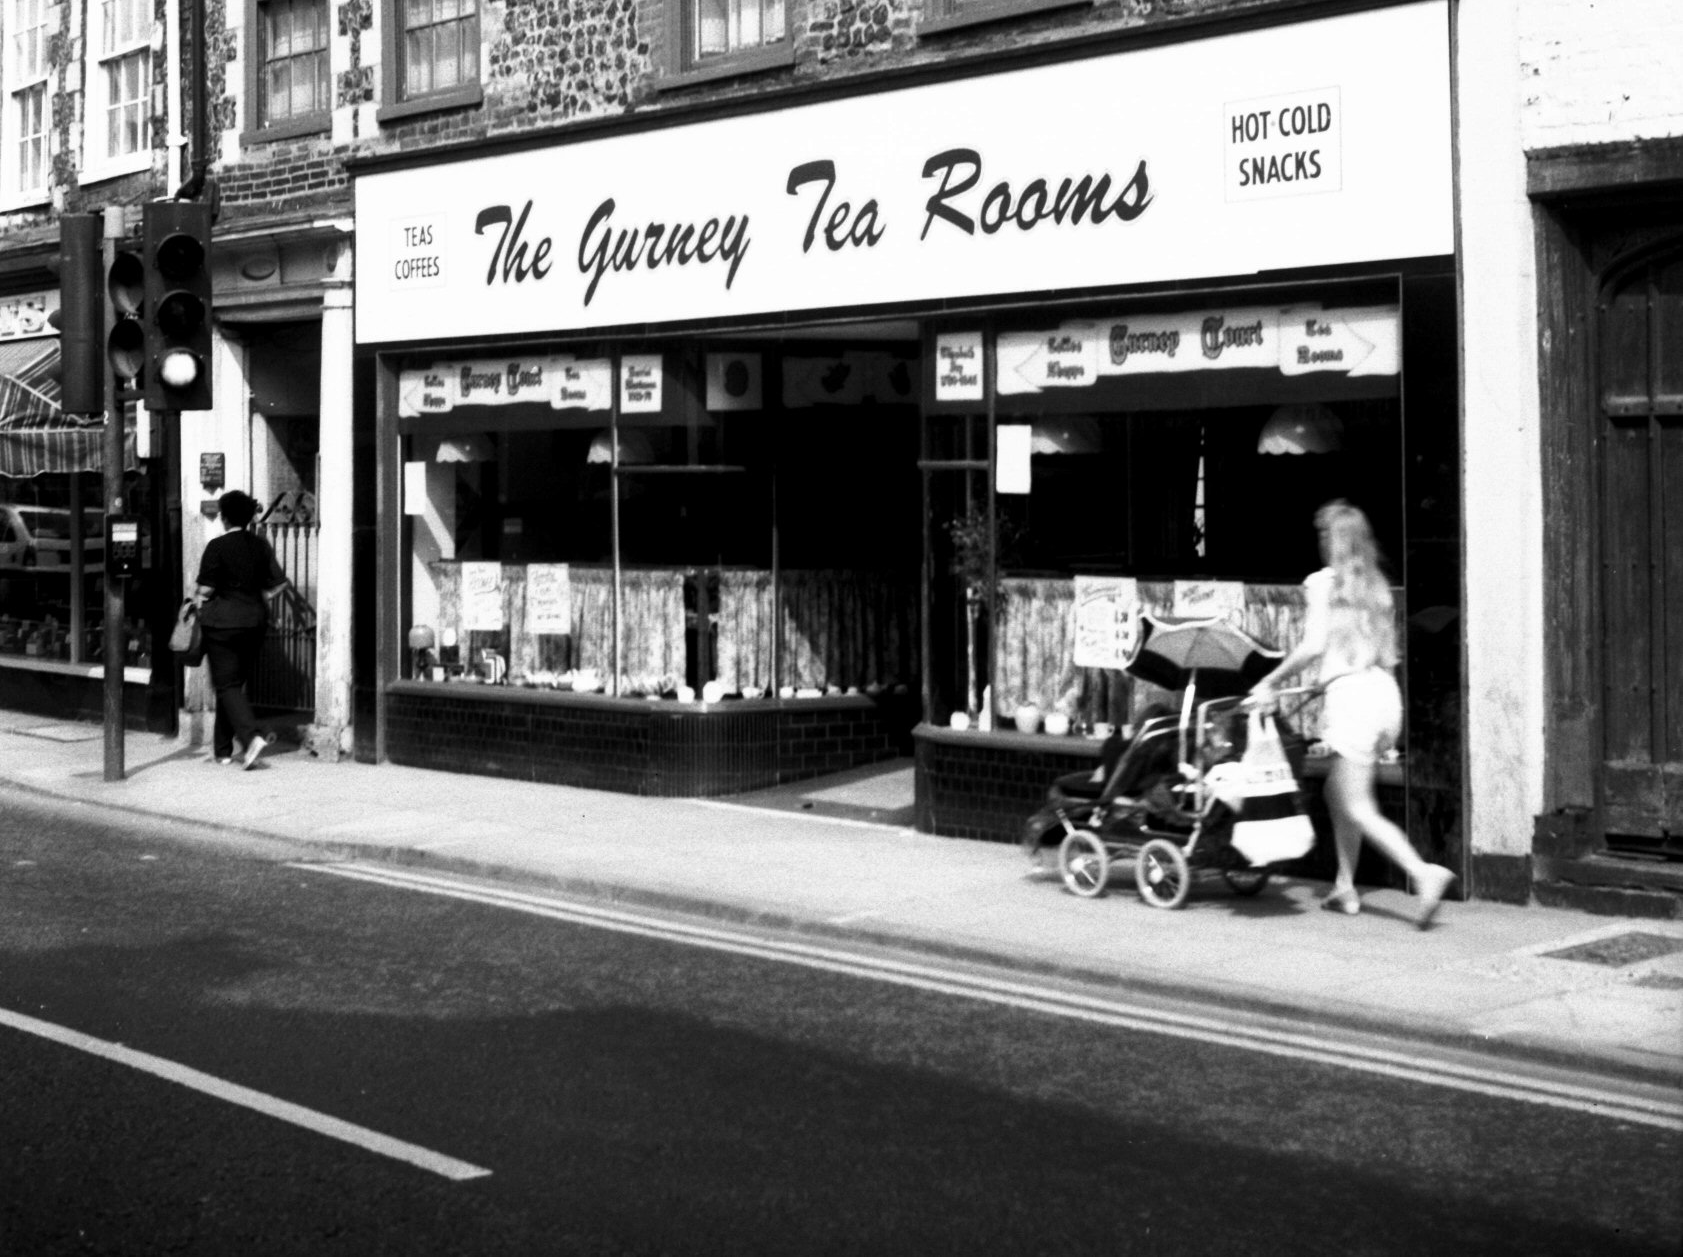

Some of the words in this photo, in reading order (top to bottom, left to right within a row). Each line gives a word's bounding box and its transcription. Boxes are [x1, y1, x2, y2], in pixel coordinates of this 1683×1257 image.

[1232, 110, 1271, 144] HOT
[1279, 102, 1331, 137] COLD
[1239, 149, 1321, 187] SNACKS
[404, 224, 433, 247] TEAS
[474, 198, 553, 286] The
[577, 198, 751, 307] Gurney
[787, 160, 886, 254] Tea
[921, 148, 1154, 241] Rooms
[395, 256, 440, 280] COFFEES
[1109, 324, 1180, 365] Gurney
[1201, 316, 1263, 358] Court
